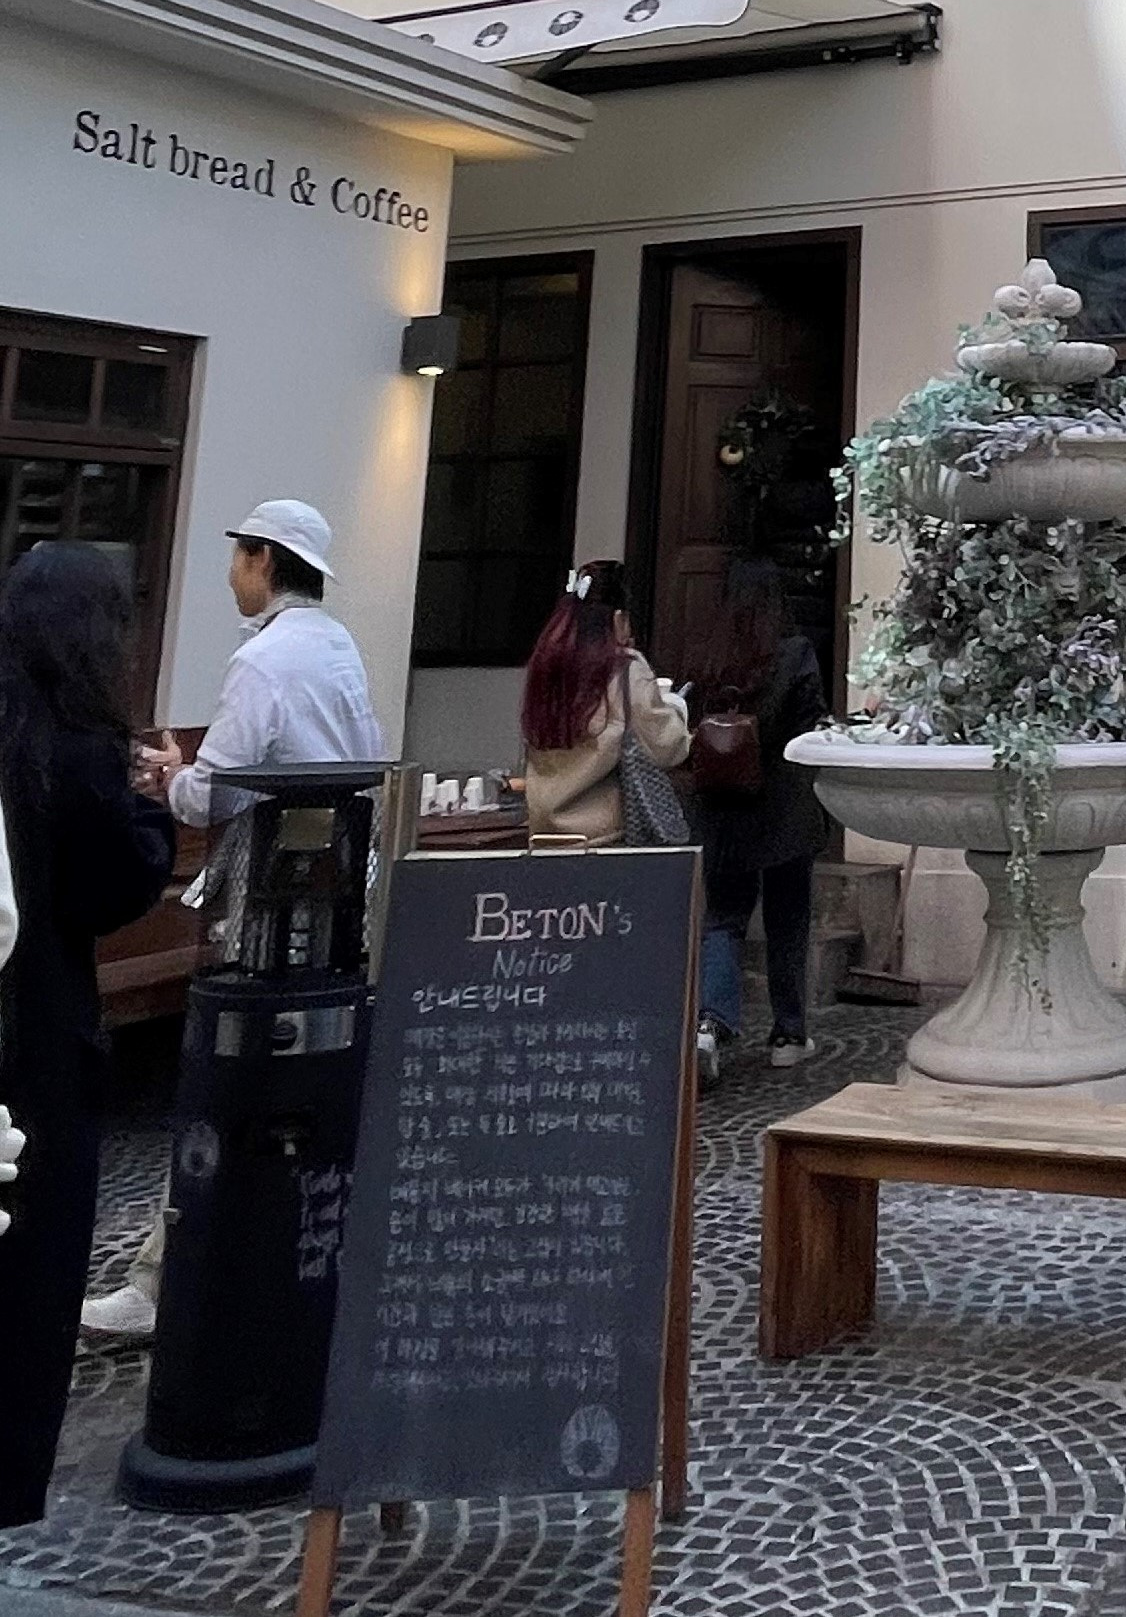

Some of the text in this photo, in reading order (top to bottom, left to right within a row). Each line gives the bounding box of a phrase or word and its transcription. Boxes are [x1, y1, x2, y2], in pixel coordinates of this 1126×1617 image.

[72, 109, 430, 234] Salt bread & Coffee
[491, 946, 574, 980] Notice
